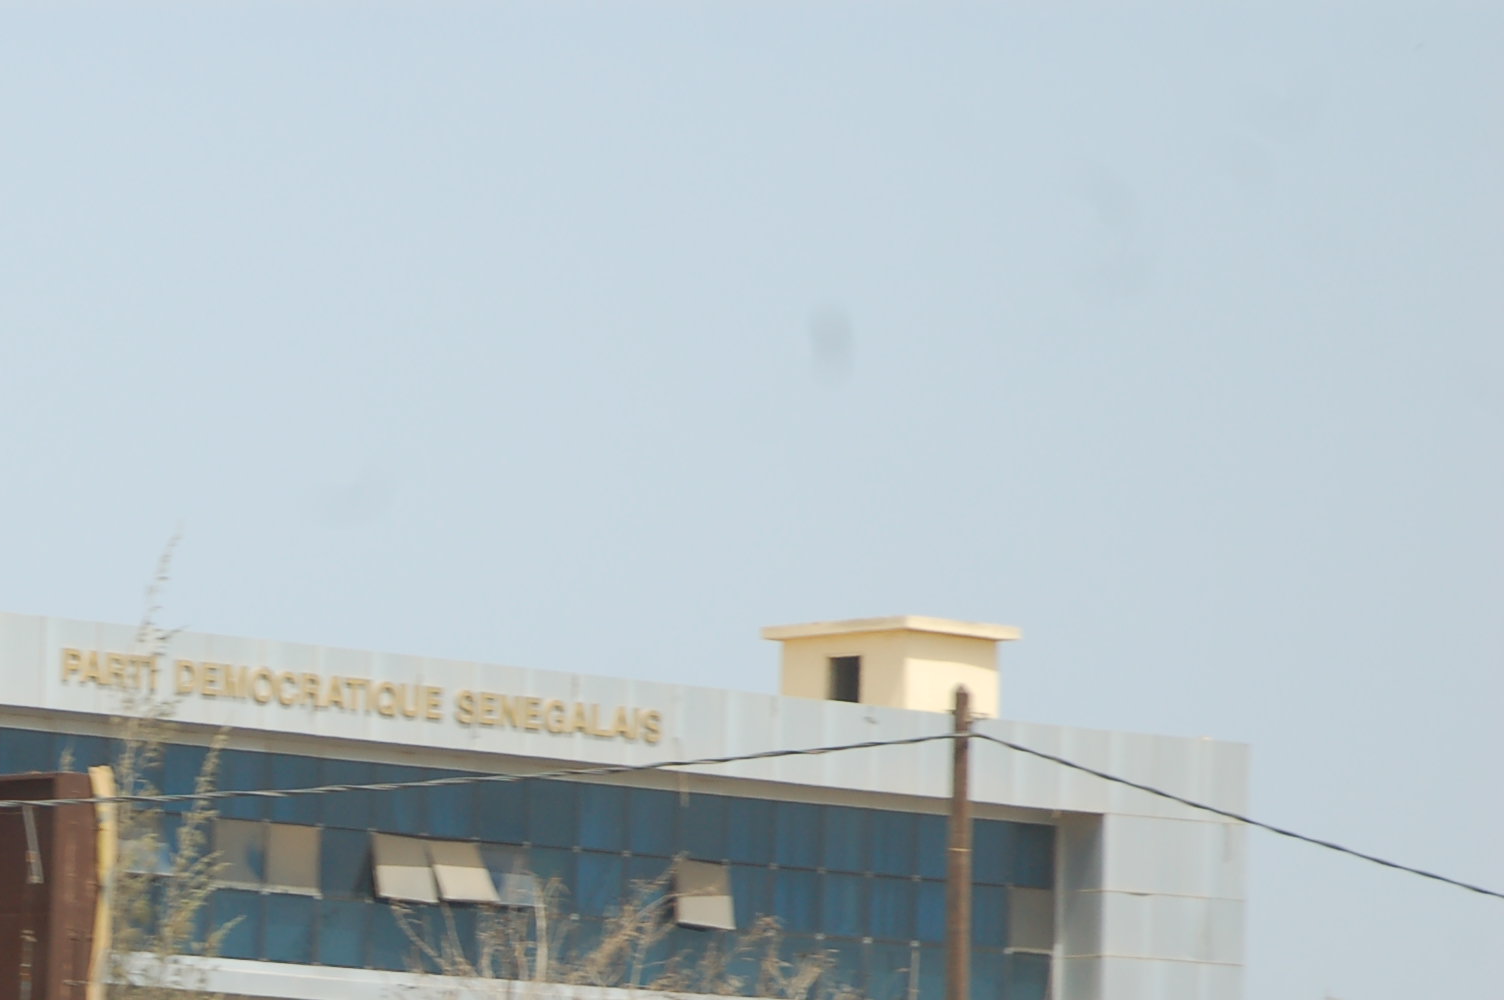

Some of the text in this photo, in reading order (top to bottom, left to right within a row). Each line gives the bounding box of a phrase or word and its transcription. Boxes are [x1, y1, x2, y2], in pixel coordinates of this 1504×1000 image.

[60, 648, 663, 744] PARTI DEMOCRATIQUE SENEGALAIS
